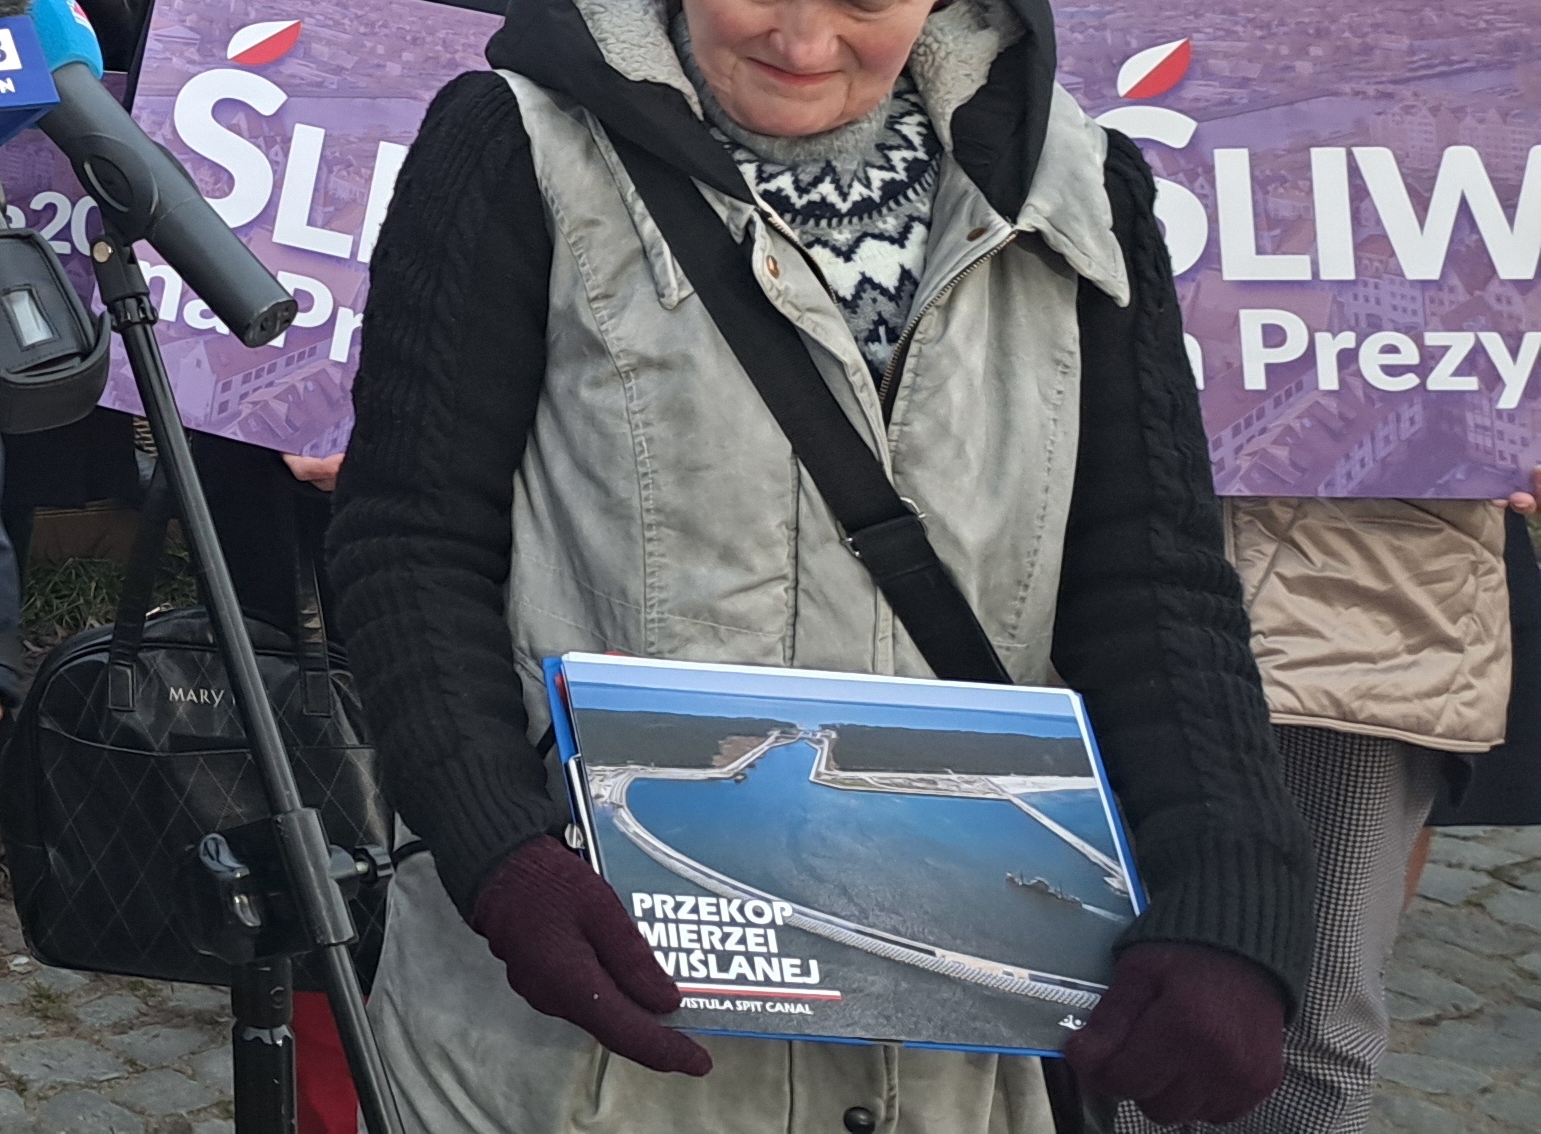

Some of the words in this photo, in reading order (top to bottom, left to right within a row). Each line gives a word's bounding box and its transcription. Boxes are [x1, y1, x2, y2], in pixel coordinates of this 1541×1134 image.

[1239, 308, 1541, 410] Prezy
[168, 686, 226, 708] MARY
[631, 892, 793, 926] PRZEKOP
[637, 921, 779, 954] MIERZEI
[735, 999, 763, 1013] SPIT
[765, 1001, 814, 1015] CANAL
